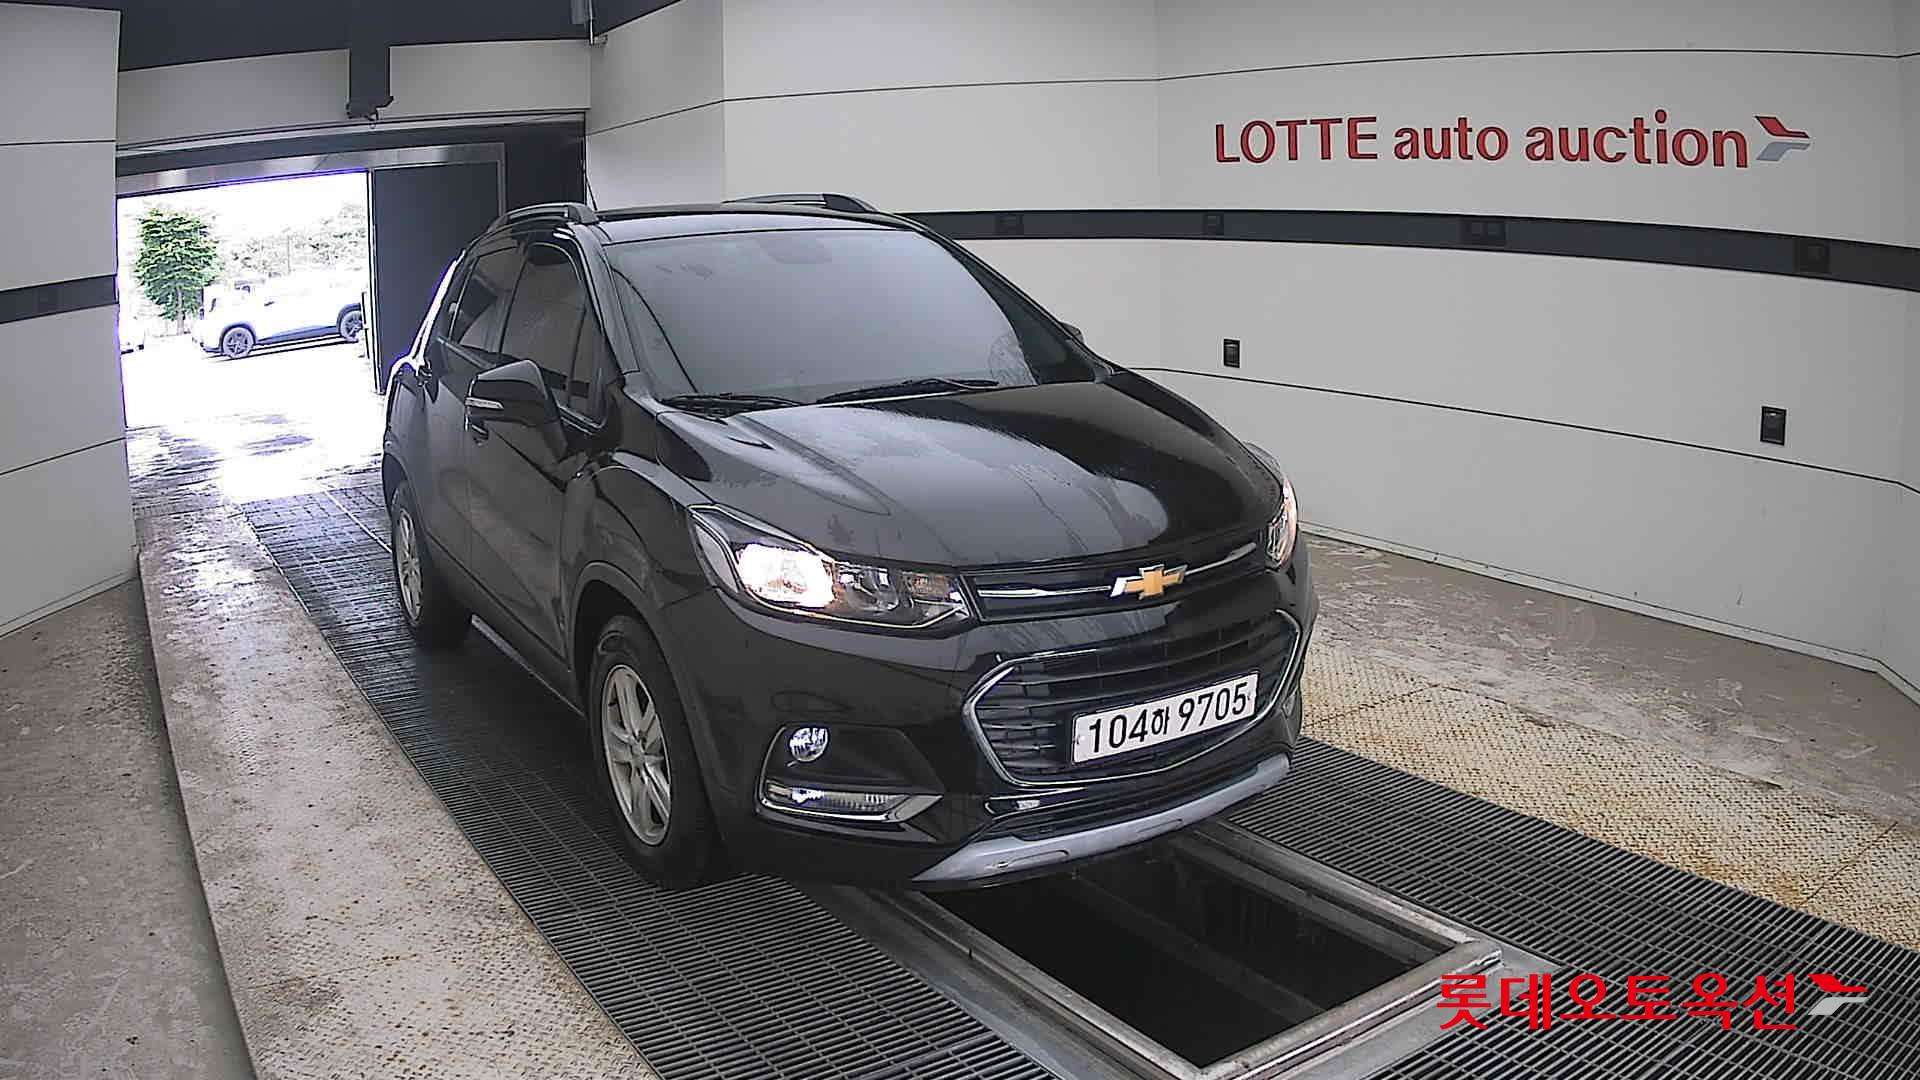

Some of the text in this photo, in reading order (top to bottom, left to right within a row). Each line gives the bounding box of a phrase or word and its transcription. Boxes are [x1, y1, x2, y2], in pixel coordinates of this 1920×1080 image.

[1215, 109, 1748, 168] LOTTE auto auction
[1088, 681, 1248, 753] 104하 9705
